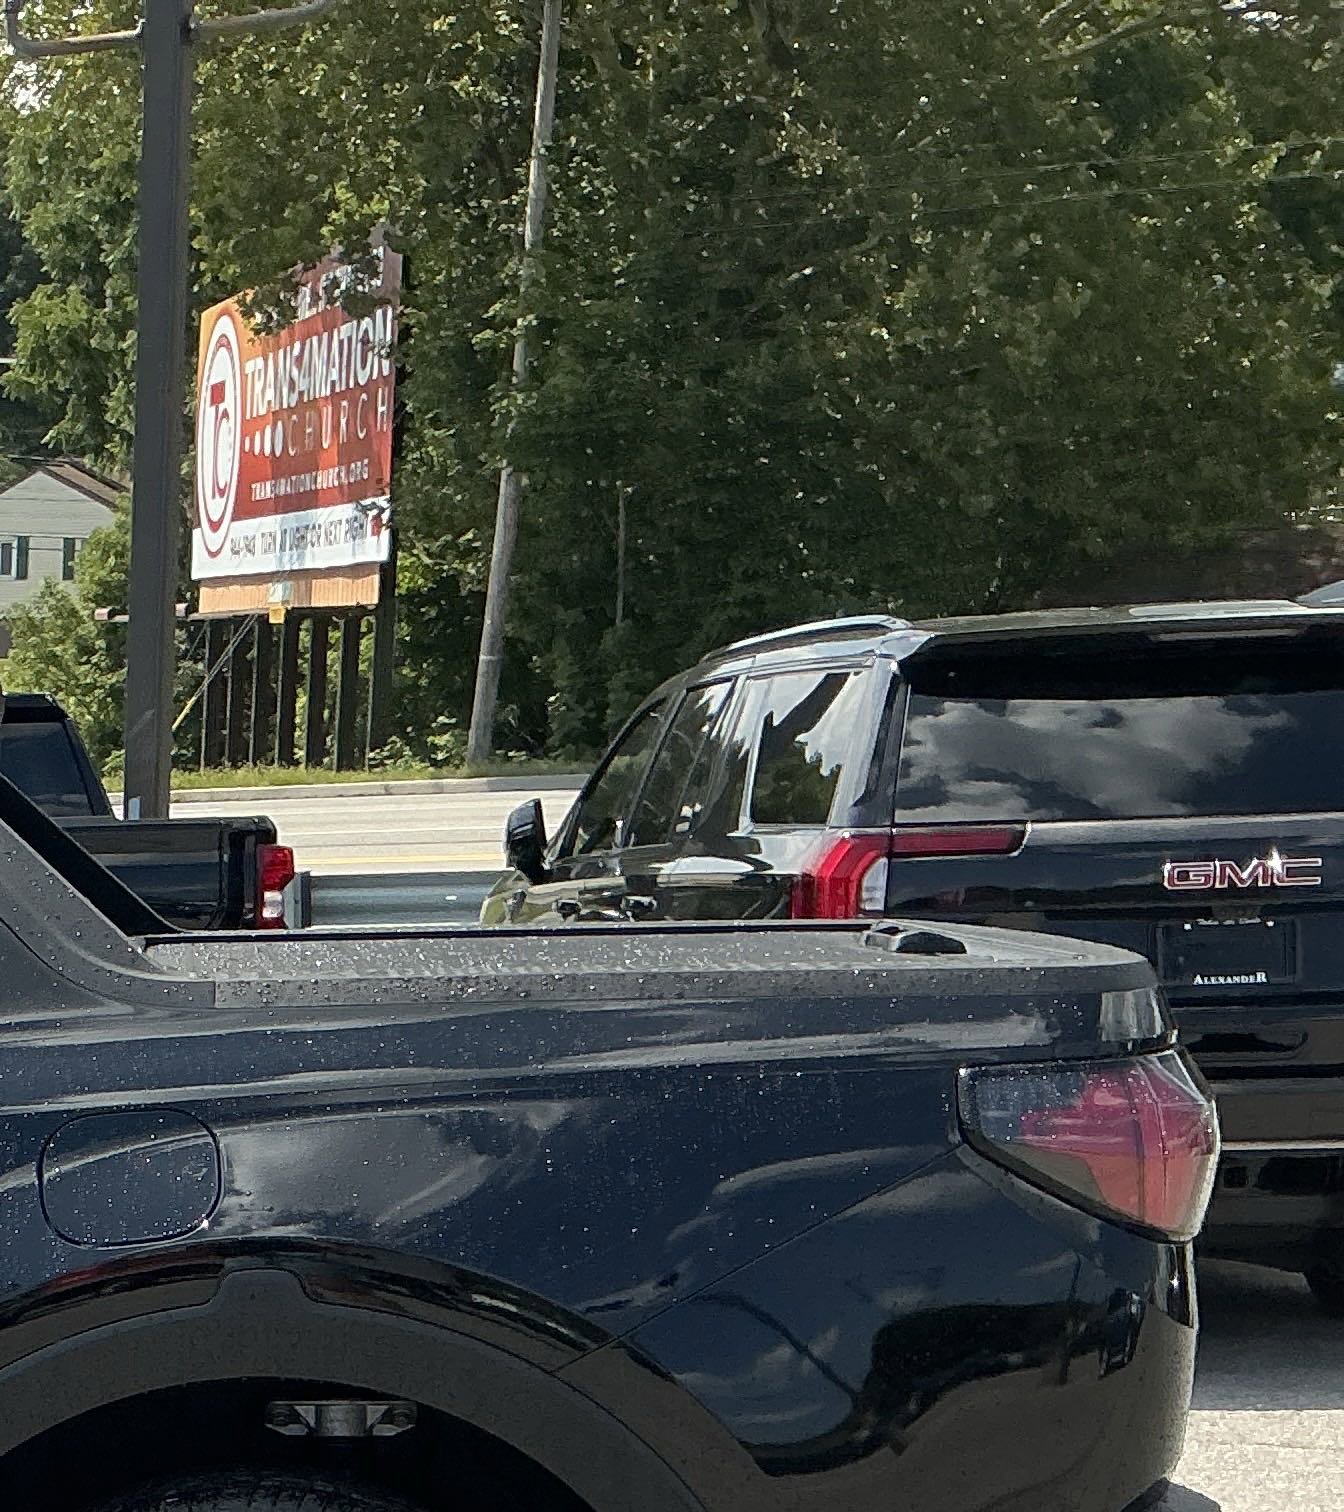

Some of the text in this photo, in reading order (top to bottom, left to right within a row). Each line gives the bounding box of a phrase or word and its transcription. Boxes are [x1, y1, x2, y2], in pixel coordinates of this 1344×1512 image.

[245, 306, 393, 419] TRANS4MATION
[288, 387, 388, 457] CHURCH
[1162, 857, 1322, 890] GMC
